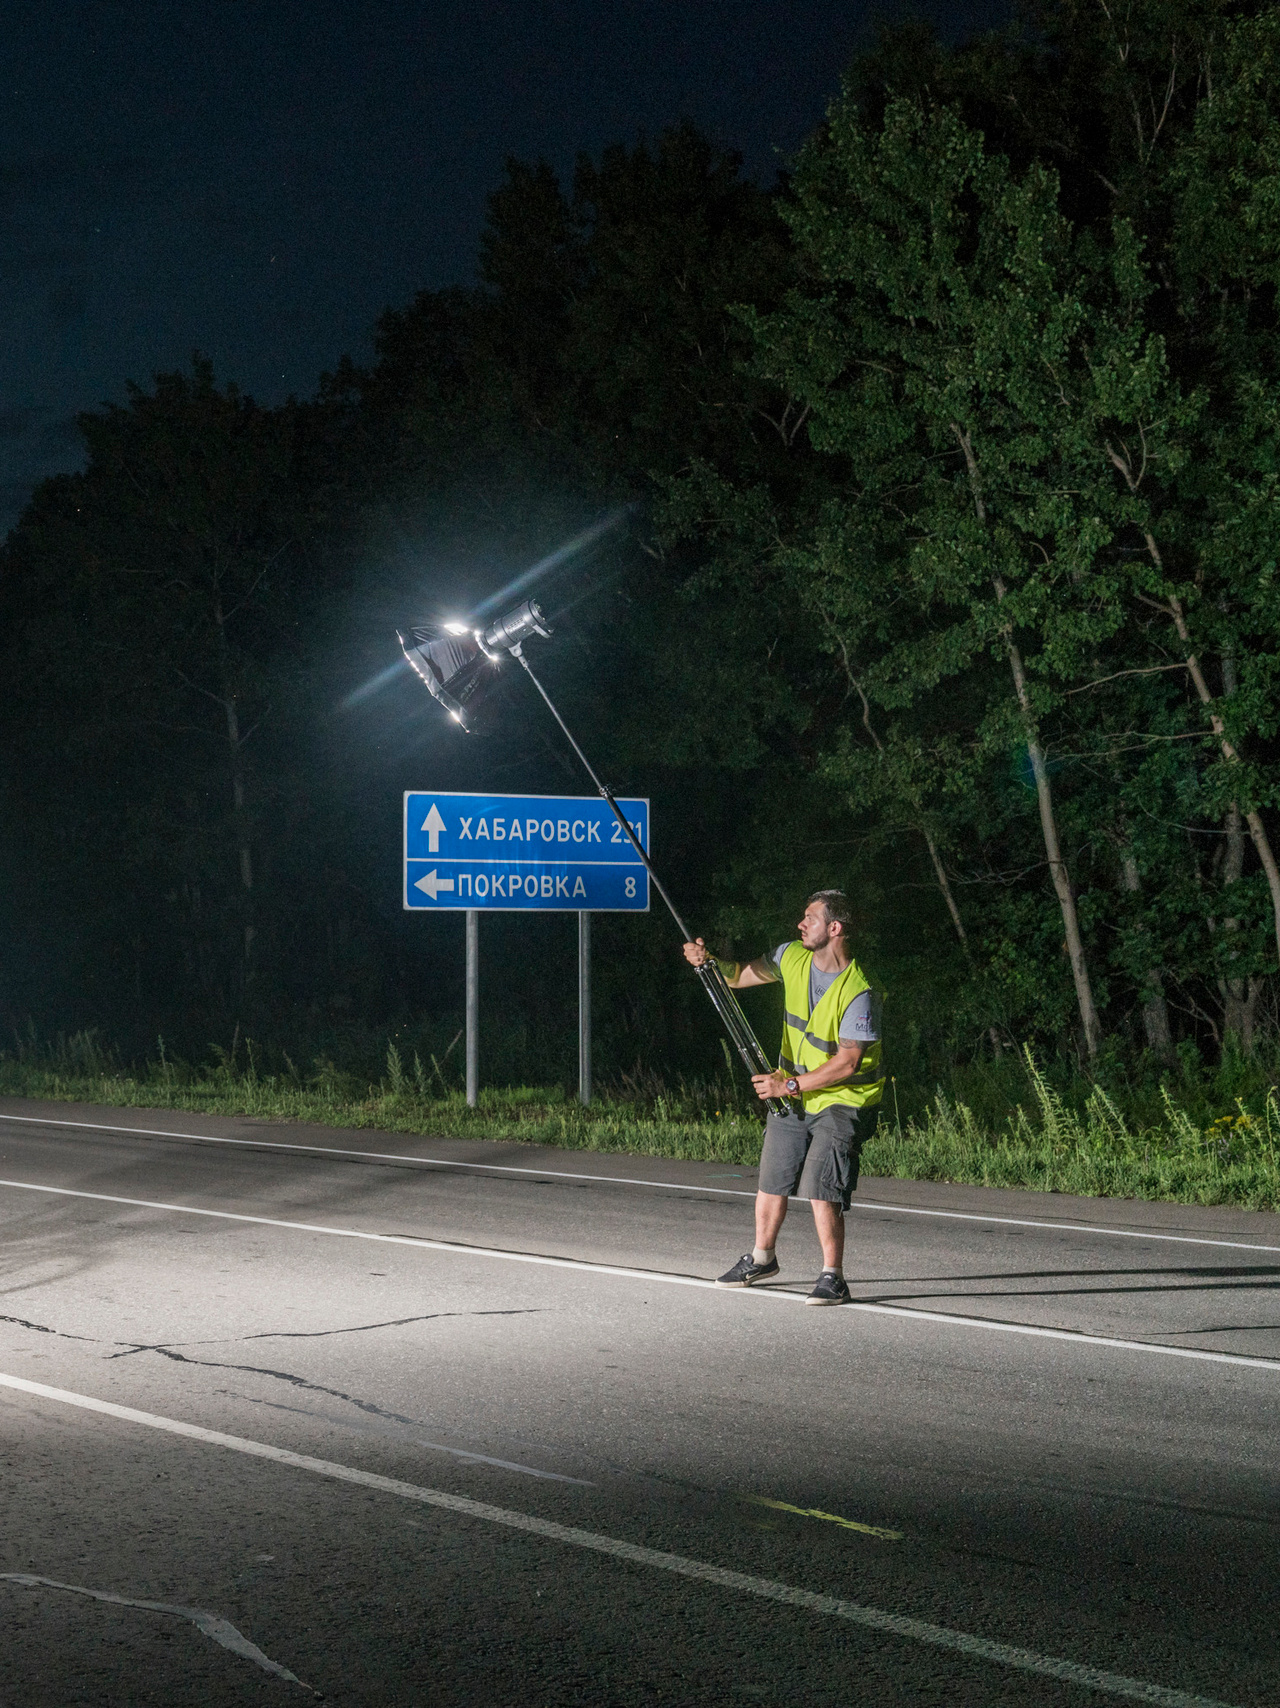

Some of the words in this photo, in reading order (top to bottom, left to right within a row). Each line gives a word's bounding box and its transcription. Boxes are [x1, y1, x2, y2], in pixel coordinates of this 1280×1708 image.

[458, 817, 602, 843] ХАБАРОВСК
[458, 874, 587, 898] ПОКРОВКА
[624, 876, 637, 898] 8
